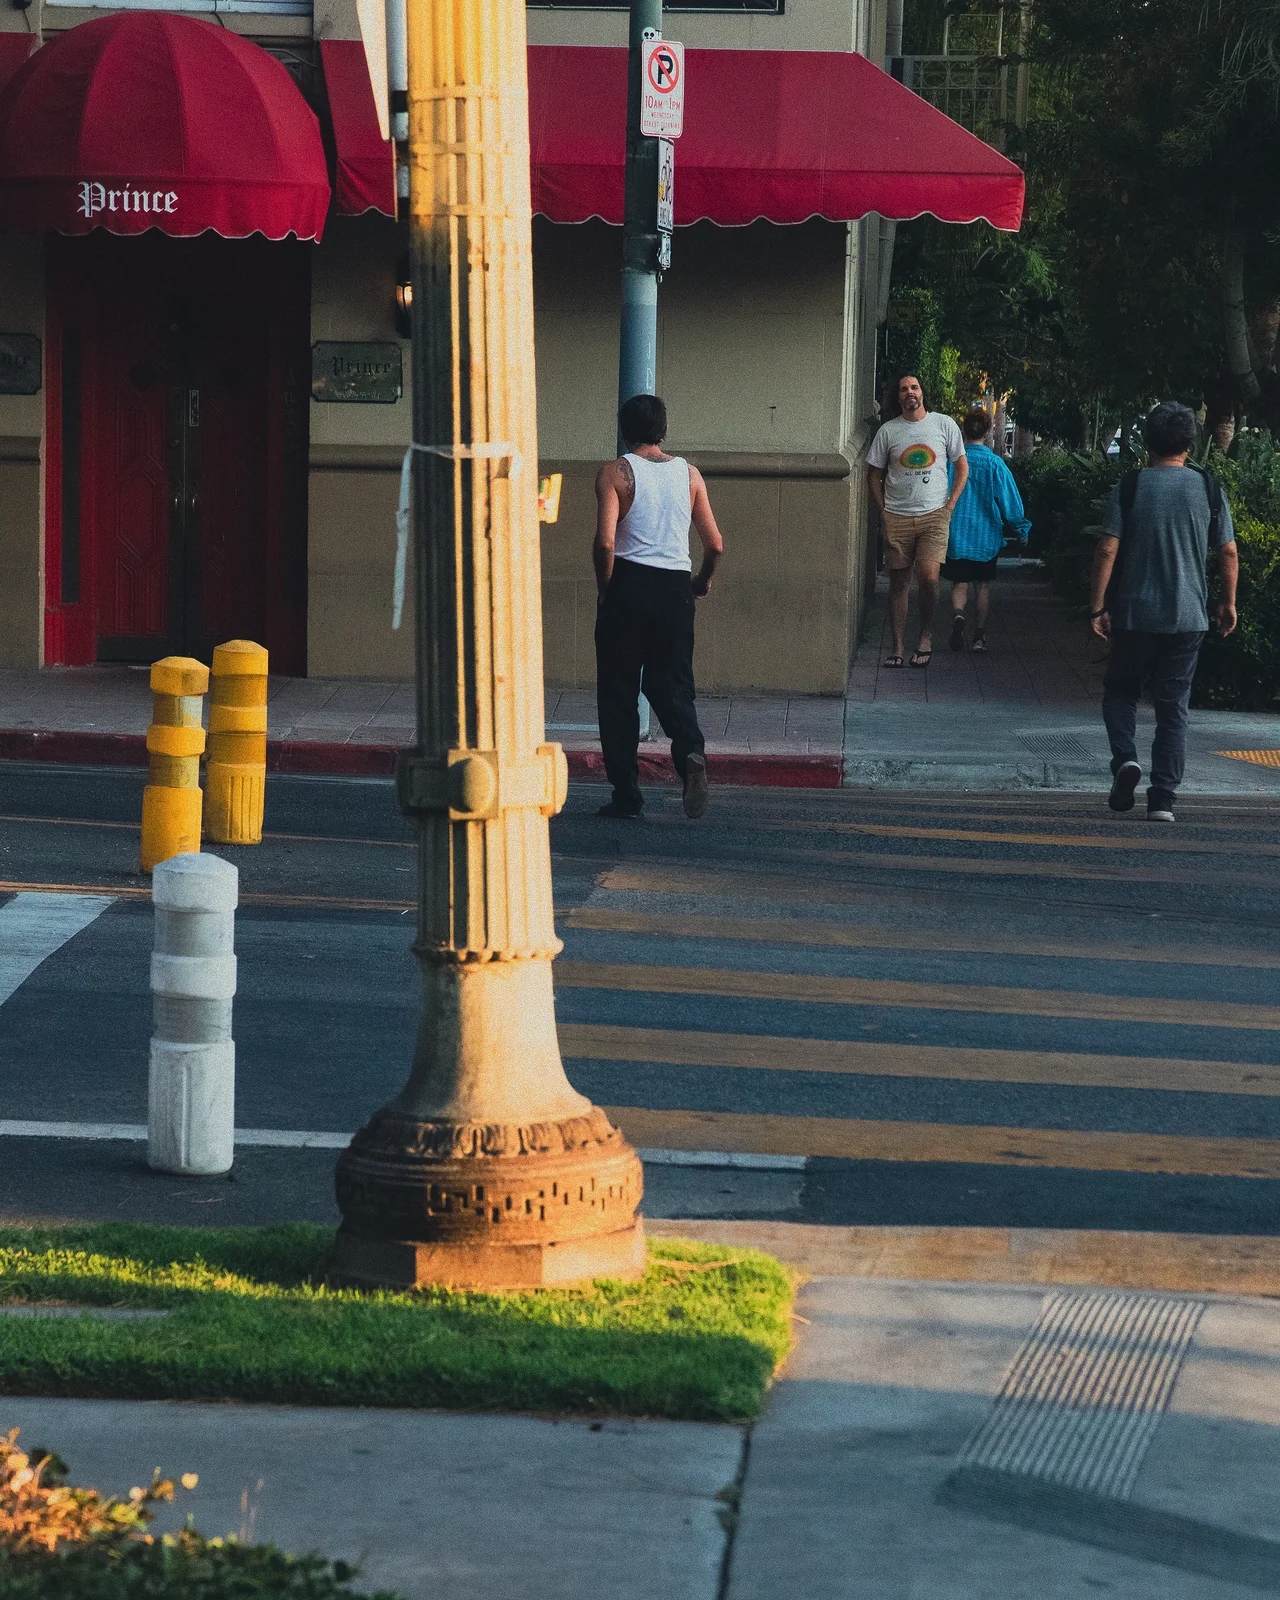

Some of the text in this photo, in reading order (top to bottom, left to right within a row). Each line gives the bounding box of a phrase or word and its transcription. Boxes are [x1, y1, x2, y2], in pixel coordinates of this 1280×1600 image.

[646, 95, 662, 109] 10AM
[77, 181, 179, 218] Prince
[0, 347, 25, 365] nce
[332, 356, 391, 377] Prince
